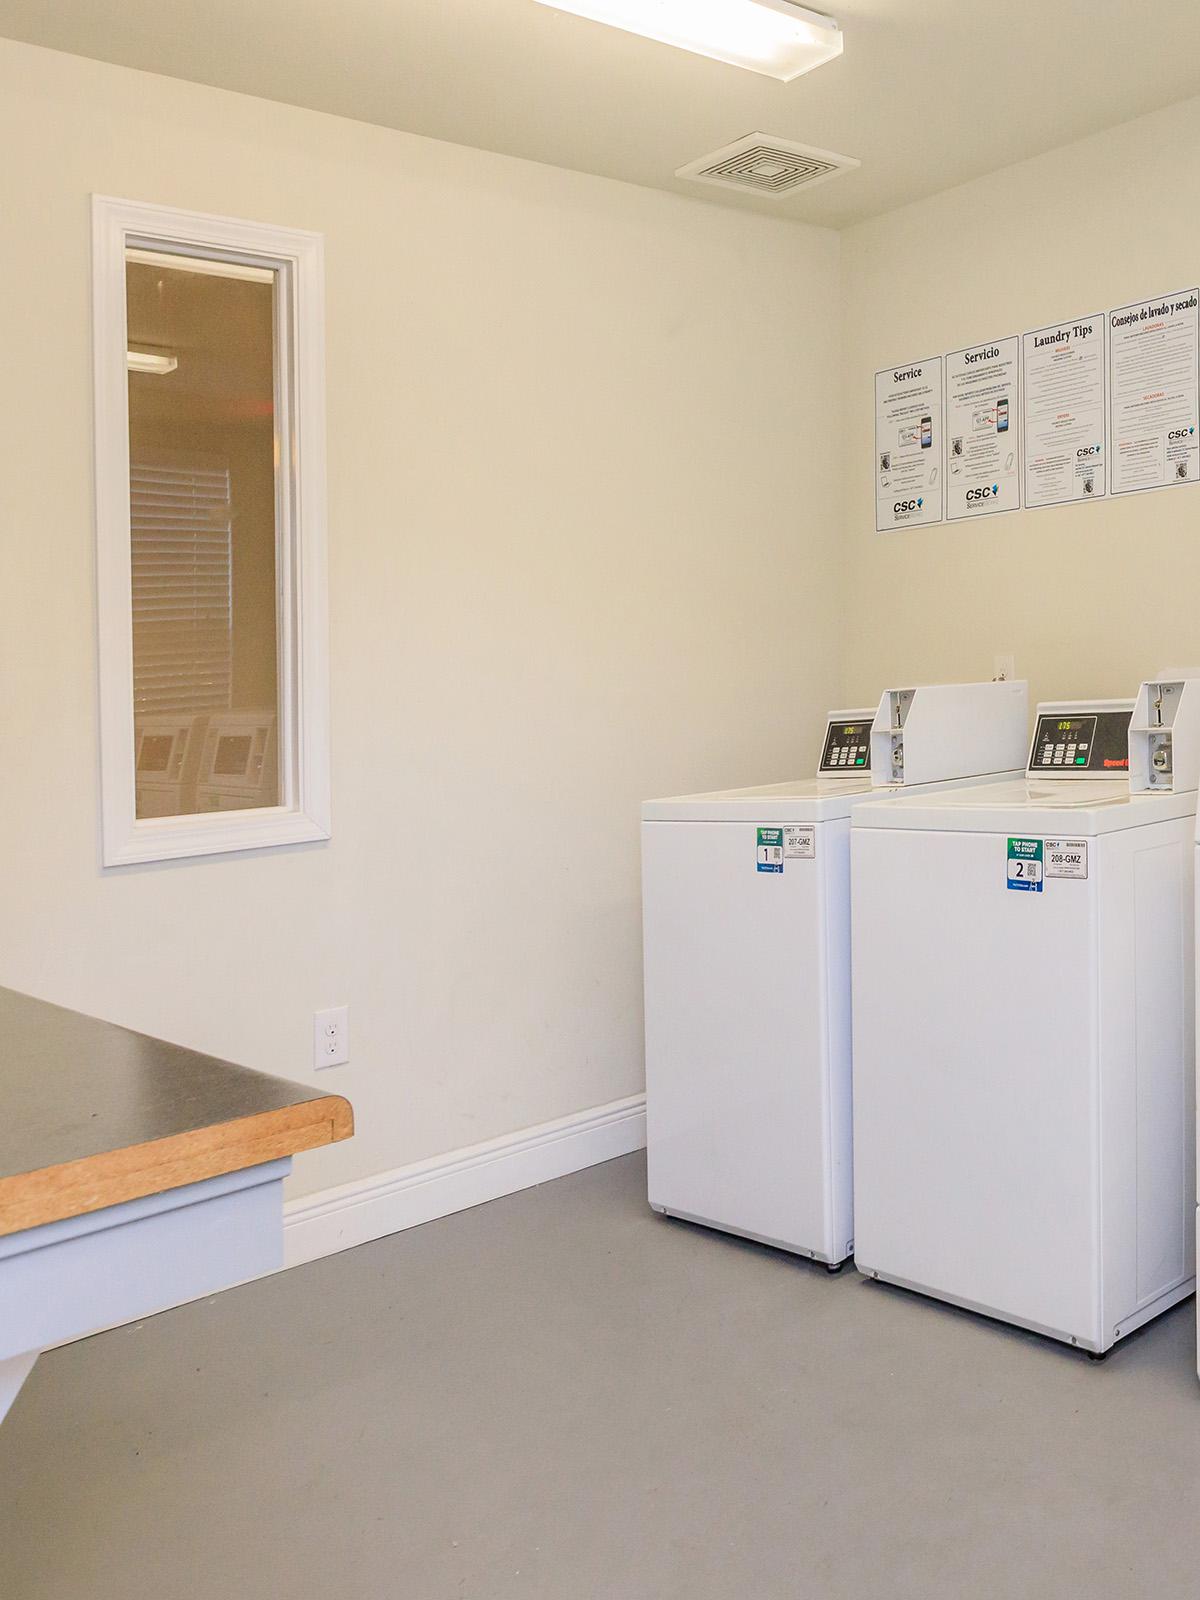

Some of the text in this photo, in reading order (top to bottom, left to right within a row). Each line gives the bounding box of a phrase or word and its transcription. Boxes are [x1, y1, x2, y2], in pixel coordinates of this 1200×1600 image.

[1112, 311, 1139, 328] Consejos
[1140, 308, 1148, 320] de
[1149, 303, 1170, 319] lavado
[1175, 295, 1198, 312] secado
[1034, 325, 1093, 348] Laundry Tips
[964, 346, 1000, 365] Servicio
[893, 367, 922, 383] Service
[1167, 428, 1188, 440] CSC
[1076, 446, 1095, 457] CSC
[965, 486, 990, 501] CSC
[893, 499, 916, 513] CSC
[1103, 759, 1125, 767] Speed
[764, 848, 768, 861] 1
[1051, 854, 1081, 864] 208-GMZ
[1016, 862, 1023, 877] 2
